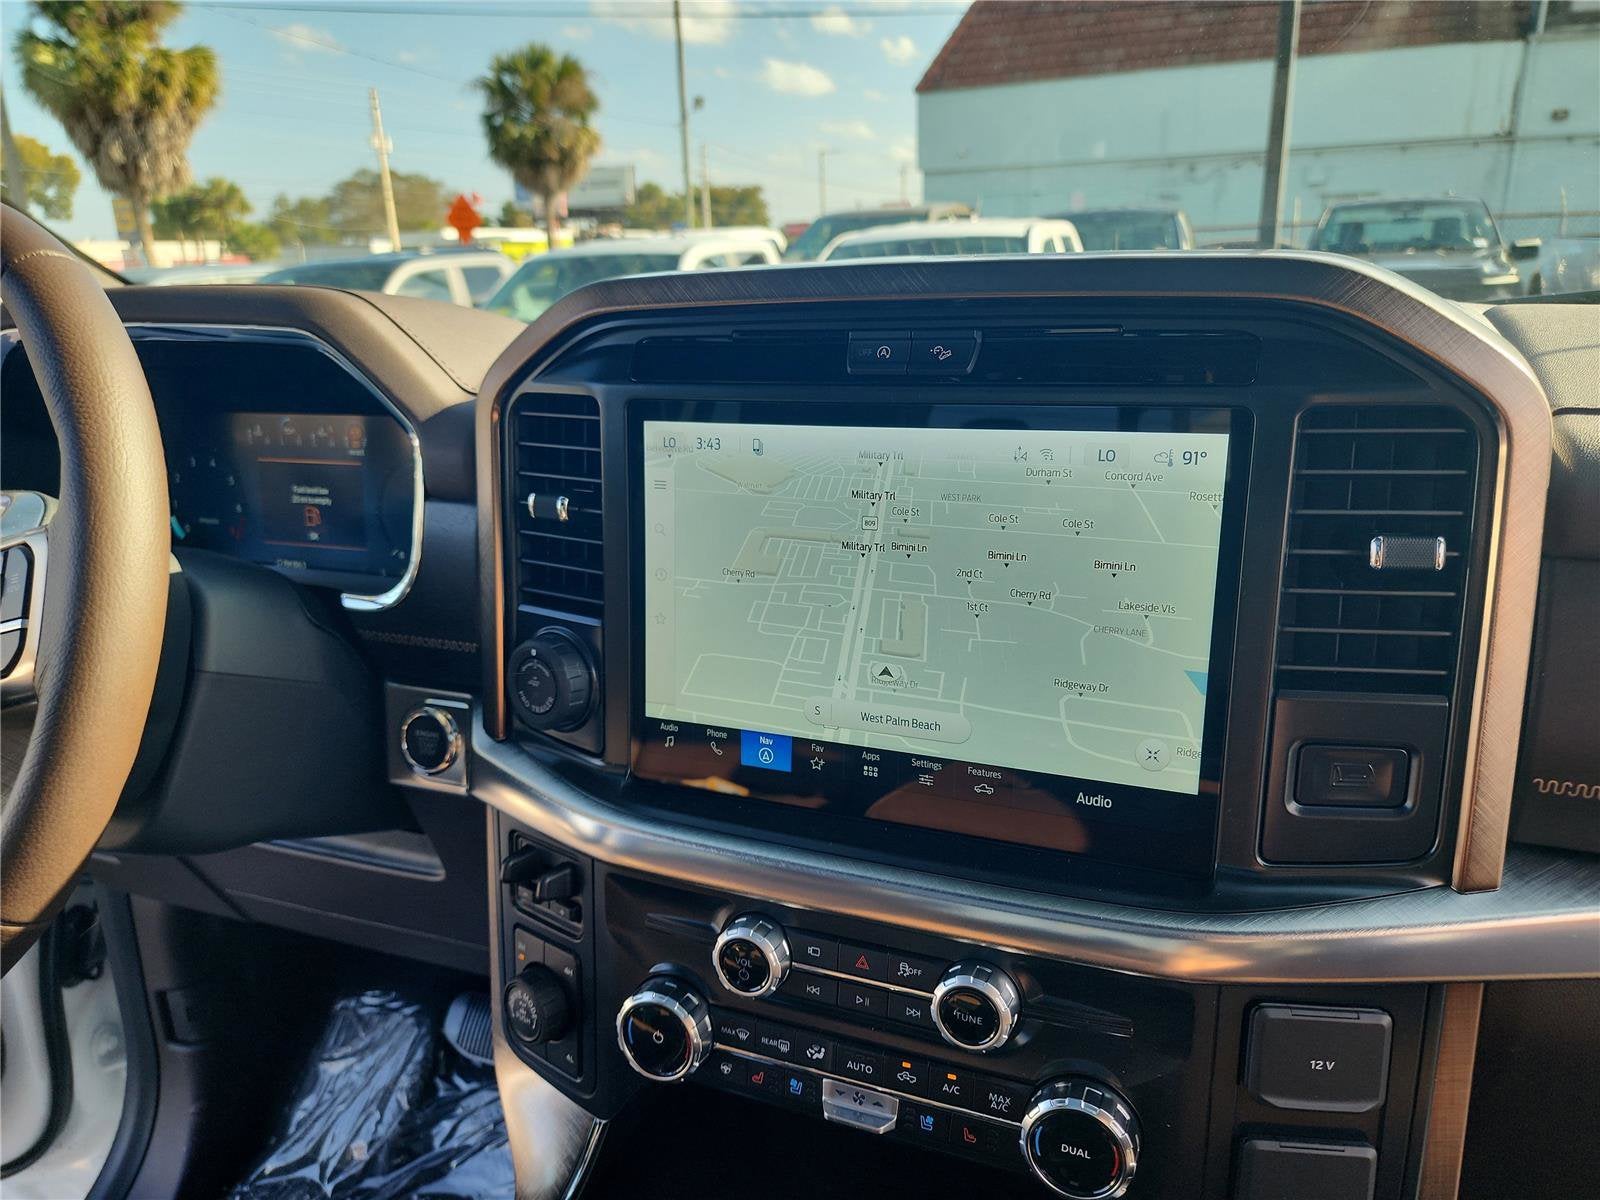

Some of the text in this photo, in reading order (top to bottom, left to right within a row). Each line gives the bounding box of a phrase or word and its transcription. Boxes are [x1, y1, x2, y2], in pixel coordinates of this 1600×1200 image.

[663, 437, 676, 448] LO
[696, 437, 721, 450] 3:43
[858, 451, 890, 462] Military
[1098, 449, 1116, 462] LO
[1025, 467, 1073, 478] Durham St
[1105, 471, 1164, 482] Concord Ave
[851, 490, 896, 502] Military Trl
[940, 493, 982, 502] WEST PARK
[891, 506, 920, 517] Cole St
[988, 513, 1019, 524] Cole St
[1062, 519, 1094, 529] Cole St
[841, 541, 885, 553] Military Trl
[891, 542, 927, 553] Bimini Ln
[987, 550, 1027, 562] Bimini Ln
[1093, 560, 1136, 572] Bimini Ln
[722, 567, 755, 578] Cherry Rd
[956, 569, 983, 579] 2nd Ct
[1009, 588, 1051, 600] Cherry Rd
[966, 602, 988, 612] 1st Ct
[1118, 601, 1176, 614] Lakeside Vls
[1093, 625, 1147, 638] CHERRY LANE
[1054, 678, 1110, 693] Ridgeway Dr
[814, 705, 821, 715] S
[660, 722, 679, 732] Audio
[860, 712, 941, 732] West Palm Beach
[706, 728, 728, 739] Phone
[759, 736, 774, 745] Nav
[811, 743, 825, 753] Fav
[862, 751, 880, 762] Apps
[911, 758, 943, 771] Settings
[967, 766, 1002, 779] Features
[1076, 791, 1113, 809] Audio
[735, 957, 752, 968] VOL
[908, 968, 923, 976] OFF
[955, 1012, 983, 1026] TUNE
[721, 1026, 736, 1035] MAX
[761, 1036, 777, 1046] REAR
[846, 1060, 873, 1074] AUTO
[1310, 1060, 1335, 1071] 12 V
[942, 1084, 960, 1095] A/C
[988, 1092, 1011, 1106] MAX
[990, 1102, 1008, 1113] A/C
[1061, 1143, 1091, 1159] DUAL
